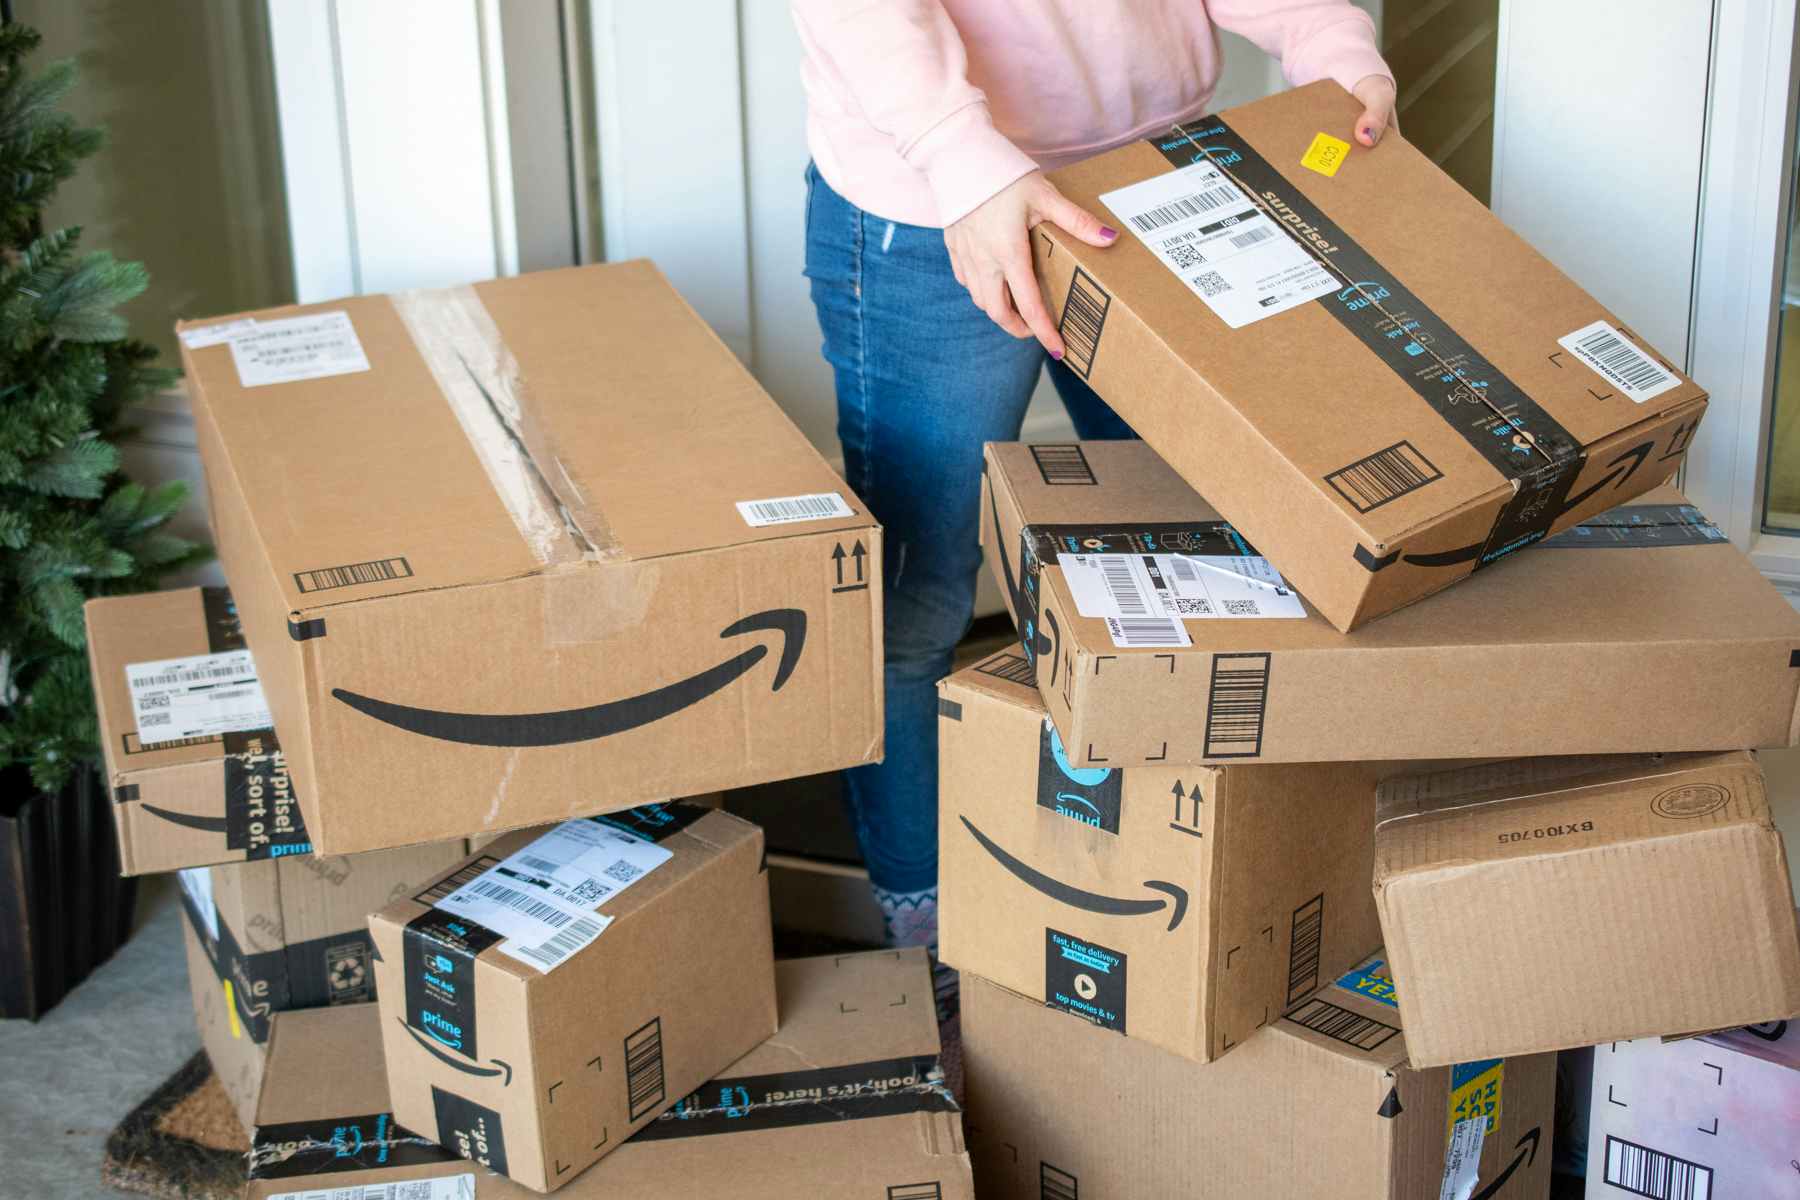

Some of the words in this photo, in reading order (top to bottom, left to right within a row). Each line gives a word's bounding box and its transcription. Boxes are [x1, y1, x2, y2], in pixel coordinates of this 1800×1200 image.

[1263, 191, 1338, 254] surprise!
[249, 775, 264, 816] sort
[249, 821, 270, 850] of.
[1497, 820, 1594, 844] BX100705
[271, 843, 313, 858] prim
[1052, 934, 1070, 948] fast,
[1071, 941, 1087, 953] free
[1087, 947, 1120, 966] delivery
[1354, 977, 1399, 1003] YEA
[1056, 992, 1069, 1005] top
[1070, 998, 1097, 1014] movies
[1098, 1008, 1105, 1017] &
[1106, 1011, 1115, 1021] tv
[423, 1010, 462, 1038] prime
[720, 1087, 737, 1118] pime
[765, 1087, 823, 1104] here!
[335, 1126, 352, 1157] pme
[472, 1118, 487, 1154] of...
